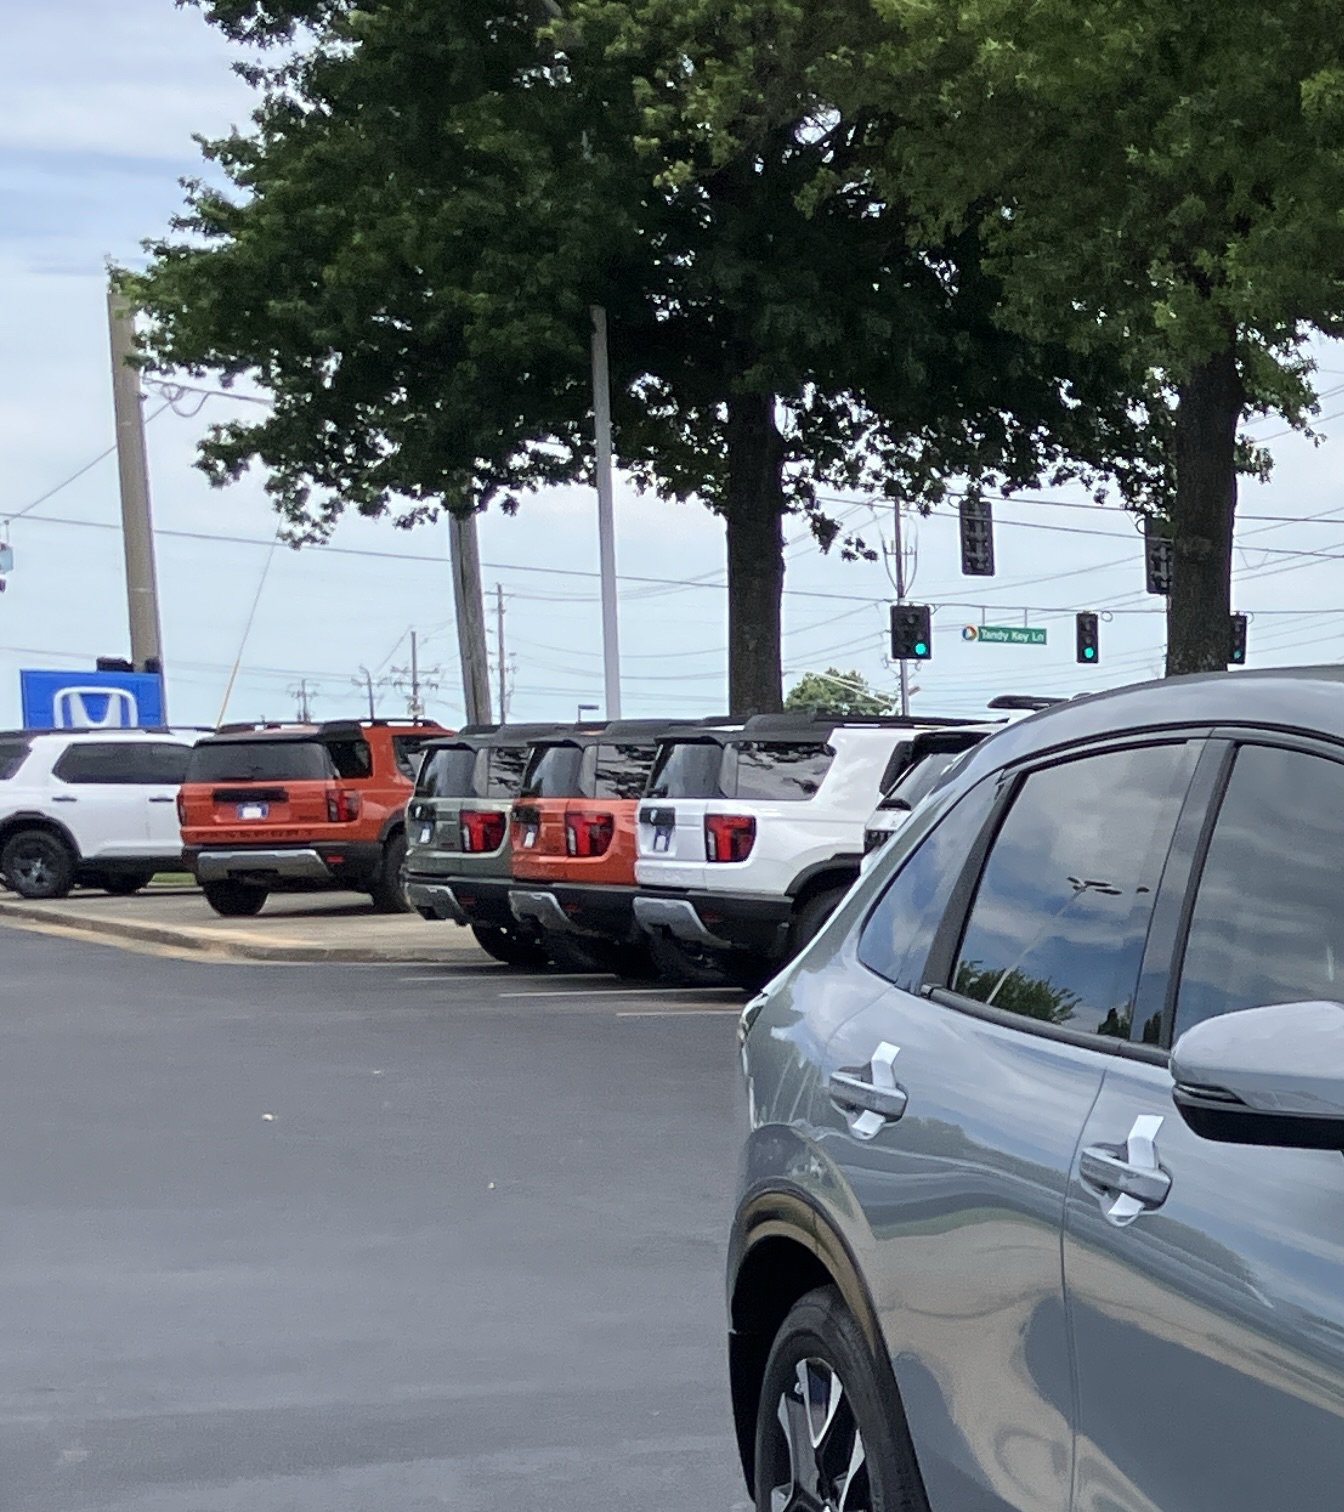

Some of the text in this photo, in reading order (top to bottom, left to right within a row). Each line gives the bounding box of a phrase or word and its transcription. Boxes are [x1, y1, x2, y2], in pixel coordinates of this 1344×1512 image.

[980, 628, 1044, 643] Tandy Key Ln
